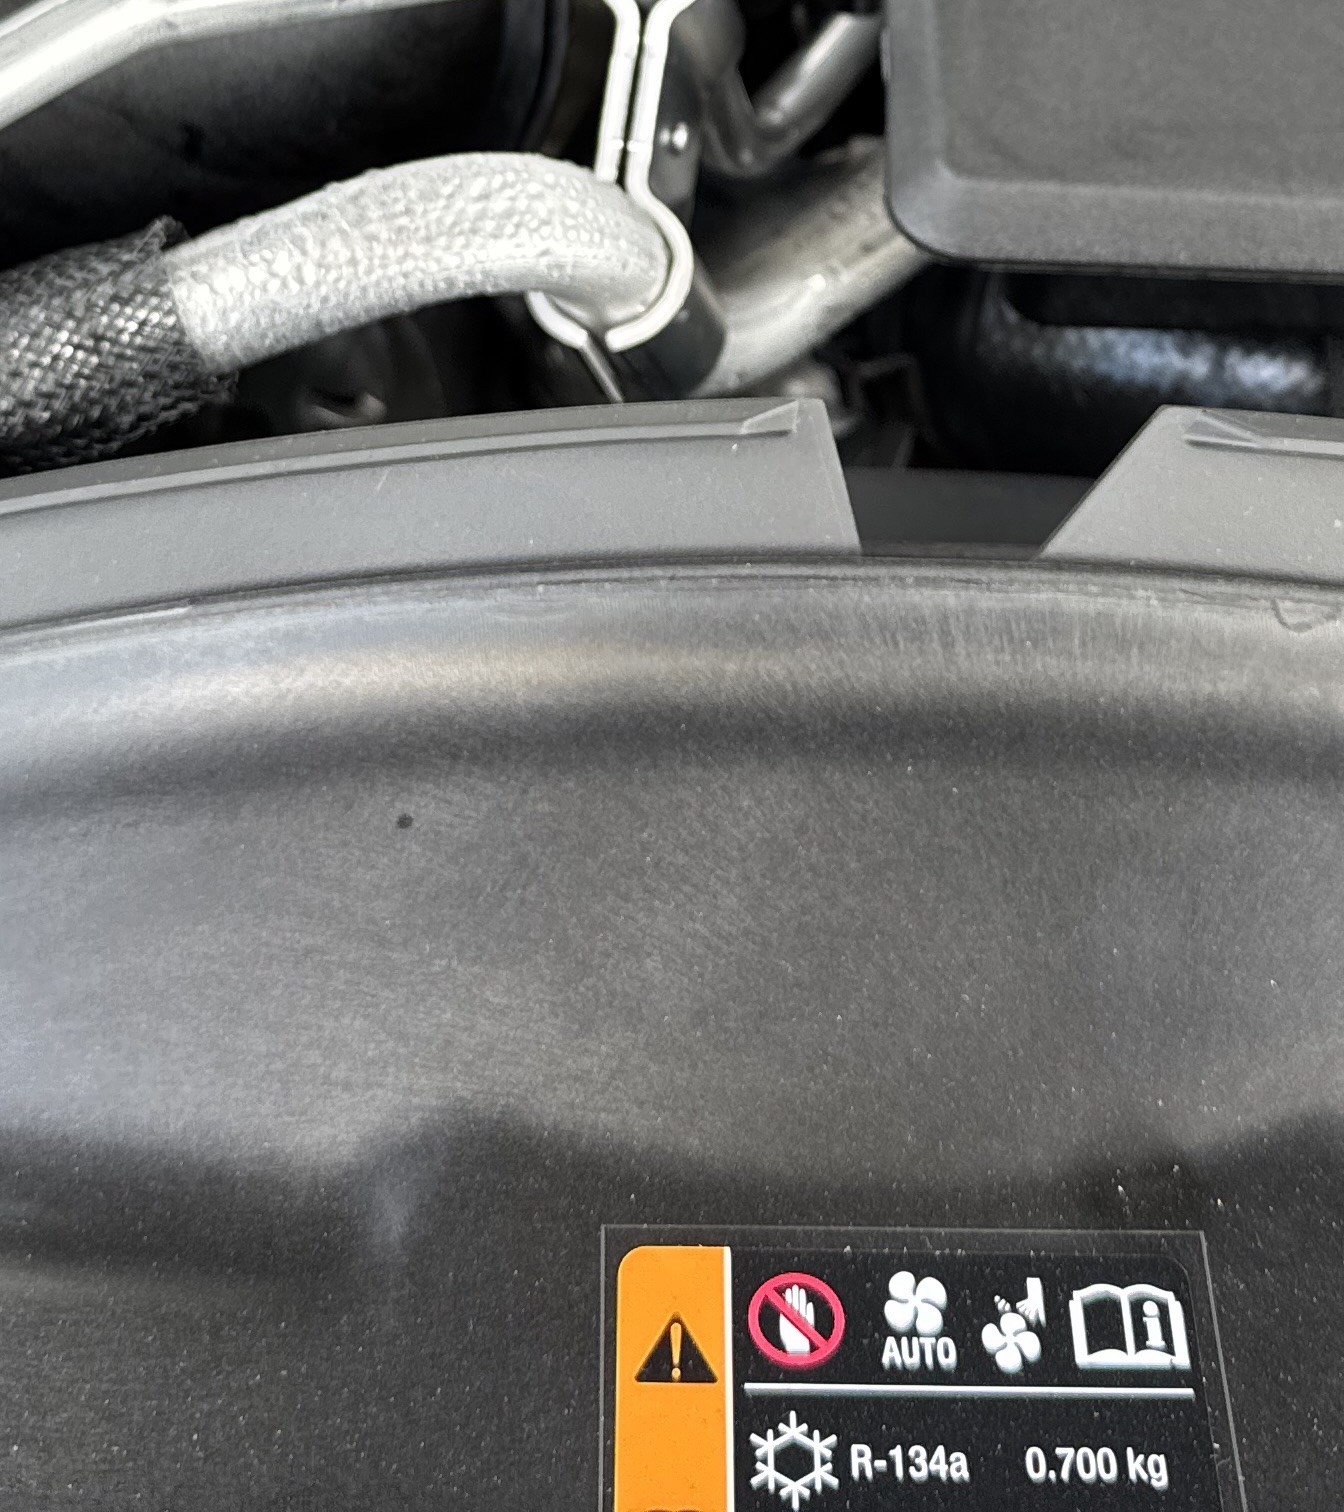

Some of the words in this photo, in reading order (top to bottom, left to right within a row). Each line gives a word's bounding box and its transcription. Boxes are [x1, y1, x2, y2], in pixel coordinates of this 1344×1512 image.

[881, 1336, 957, 1371] AUTO
[850, 1443, 971, 1483] R-134a
[1025, 1445, 1119, 1484] 0.700
[1126, 1446, 1169, 1491] kg
